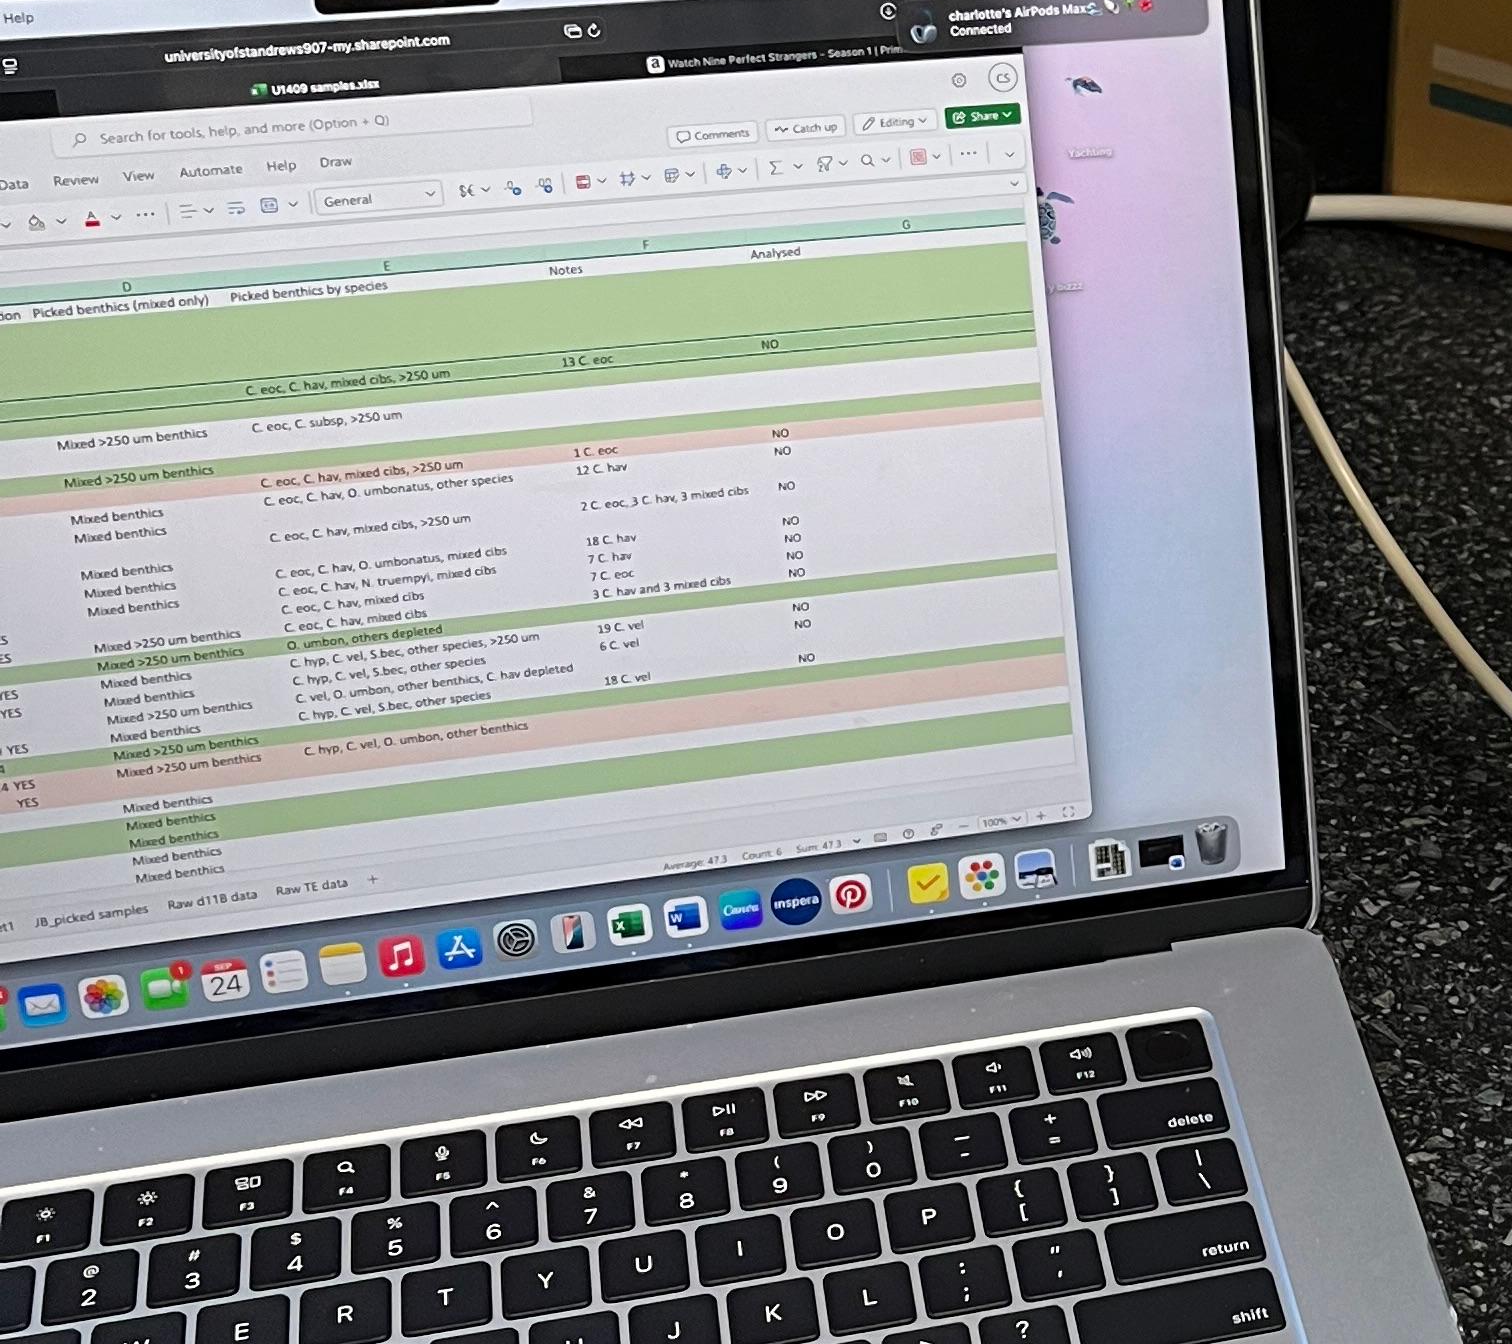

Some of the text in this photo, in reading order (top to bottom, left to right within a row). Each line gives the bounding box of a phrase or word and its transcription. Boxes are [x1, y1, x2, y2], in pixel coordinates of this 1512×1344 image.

[3, 11, 34, 25] Help
[949, 3, 1088, 22] charlotte's AirPods Max
[950, 21, 1012, 36] Connected
[165, 36, 450, 62] universityofstandrews907-my.sharepoint.com
[668, 58, 701, 68] Watch
[703, 57, 726, 66] Nine
[729, 54, 766, 64] Perfect
[768, 52, 817, 62] Strangers
[828, 49, 865, 58] Season
[867, 47, 872, 55] 1
[271, 79, 380, 95] U1409 samples.xlsx
[880, 115, 915, 129] Editing
[970, 110, 999, 122] Share
[100, 115, 389, 144] Search for tools, help, and more (Option Q)
[695, 129, 750, 141] Comments
[792, 123, 838, 136] Catch up
[267, 160, 297, 174] Help
[320, 157, 352, 168] Draw
[122, 171, 154, 181] View
[180, 166, 242, 178] Automate
[54, 176, 98, 186] Review
[324, 194, 372, 207] General
[750, 247, 801, 262] Analysed
[549, 264, 584, 276] Notes
[230, 280, 388, 302] Picked benthics by species
[32, 294, 209, 319] Picked benthics (mixed only)
[761, 339, 779, 349] NO
[57, 430, 208, 451] Mixed >250 um benthics
[772, 428, 789, 438] NO
[352, 632, 389, 644] others
[392, 625, 443, 640] depleted
[13, 779, 35, 792] YES
[983, 817, 1008, 828] 100%
[276, 880, 348, 895] Raw TE data
[168, 892, 258, 910] Raw d11B data
[774, 895, 820, 910] inspera
[35, 905, 148, 928] JB_picked samples
[210, 974, 243, 996] 24
[1168, 1114, 1213, 1127] delete
[922, 1208, 936, 1225] P
[827, 1224, 844, 1240] O
[737, 1241, 743, 1256] I
[1202, 1241, 1249, 1257] return
[635, 1256, 652, 1272] U
[538, 1272, 553, 1288] Y
[437, 1288, 453, 1305] T
[863, 1289, 877, 1306] L
[338, 1305, 353, 1323] R
[766, 1304, 782, 1322] K
[1232, 1308, 1268, 1324] shift
[235, 1323, 249, 1341] E
[668, 1322, 680, 1339] J
